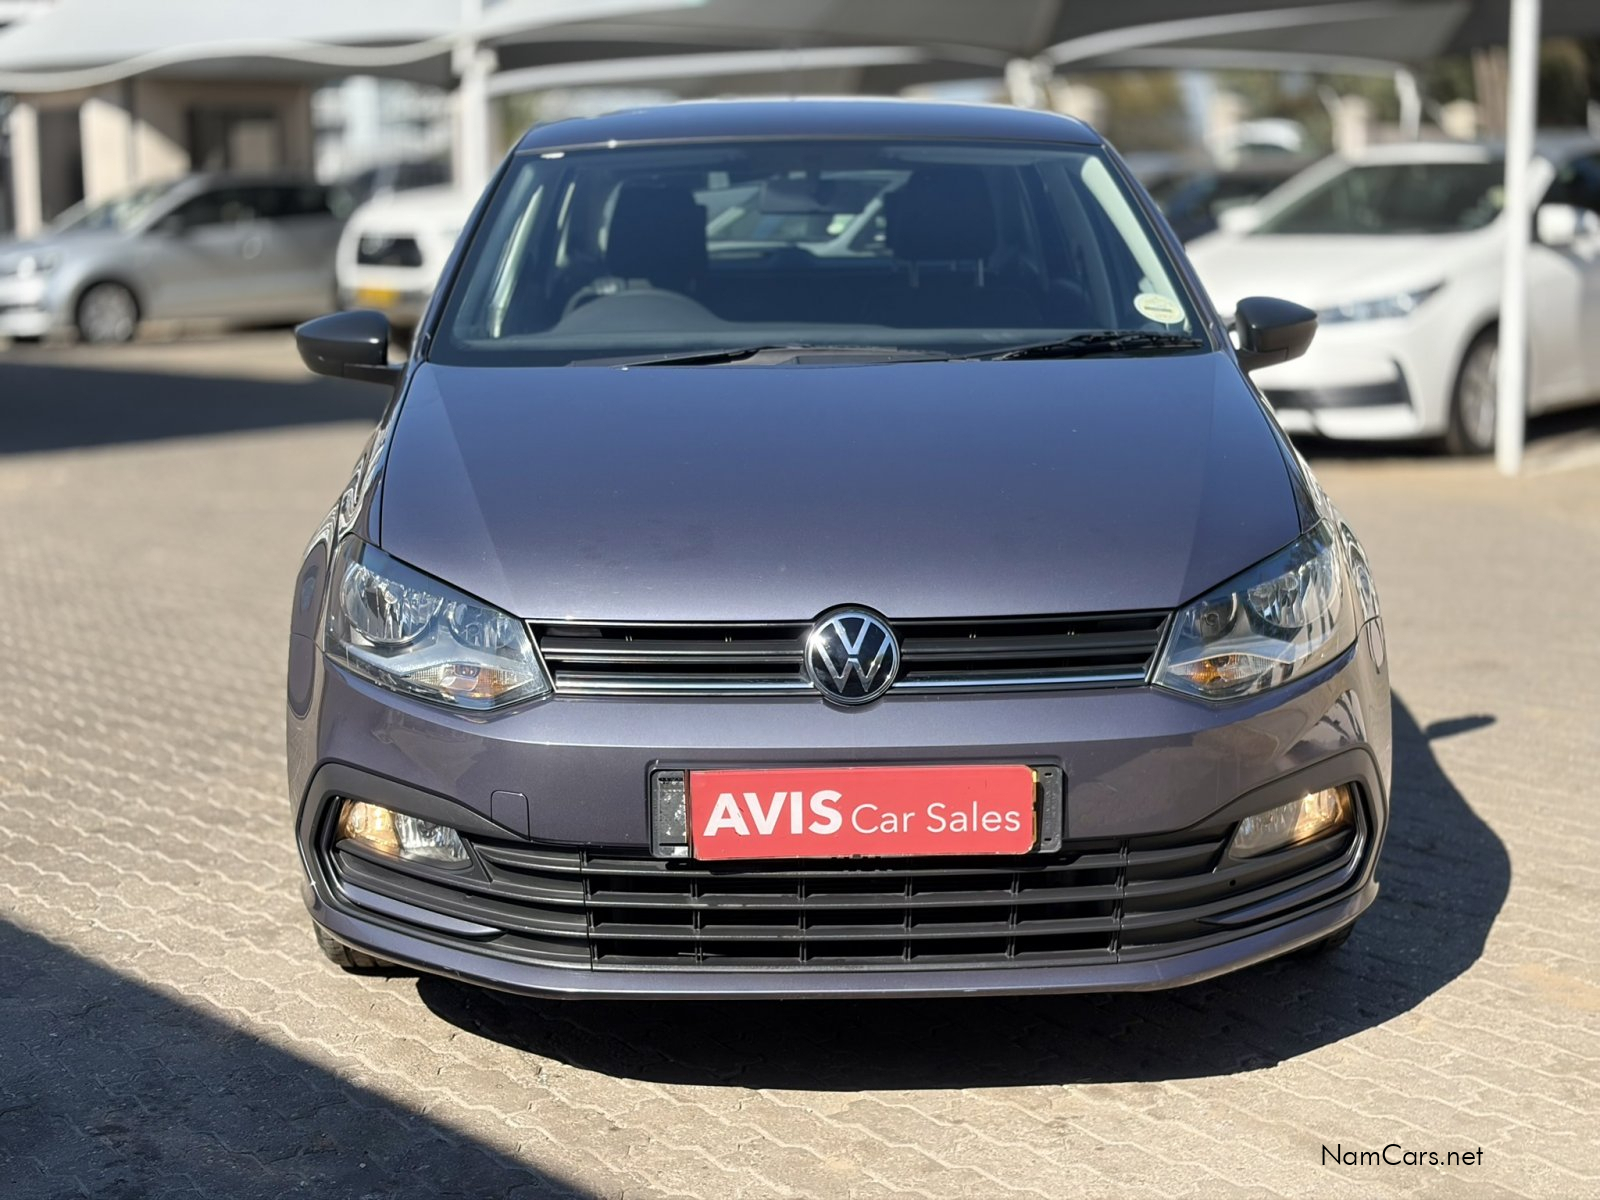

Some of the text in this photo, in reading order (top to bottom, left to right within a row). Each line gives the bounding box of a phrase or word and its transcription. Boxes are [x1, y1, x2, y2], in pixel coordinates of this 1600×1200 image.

[703, 790, 1021, 837] AVIS Car Sales
